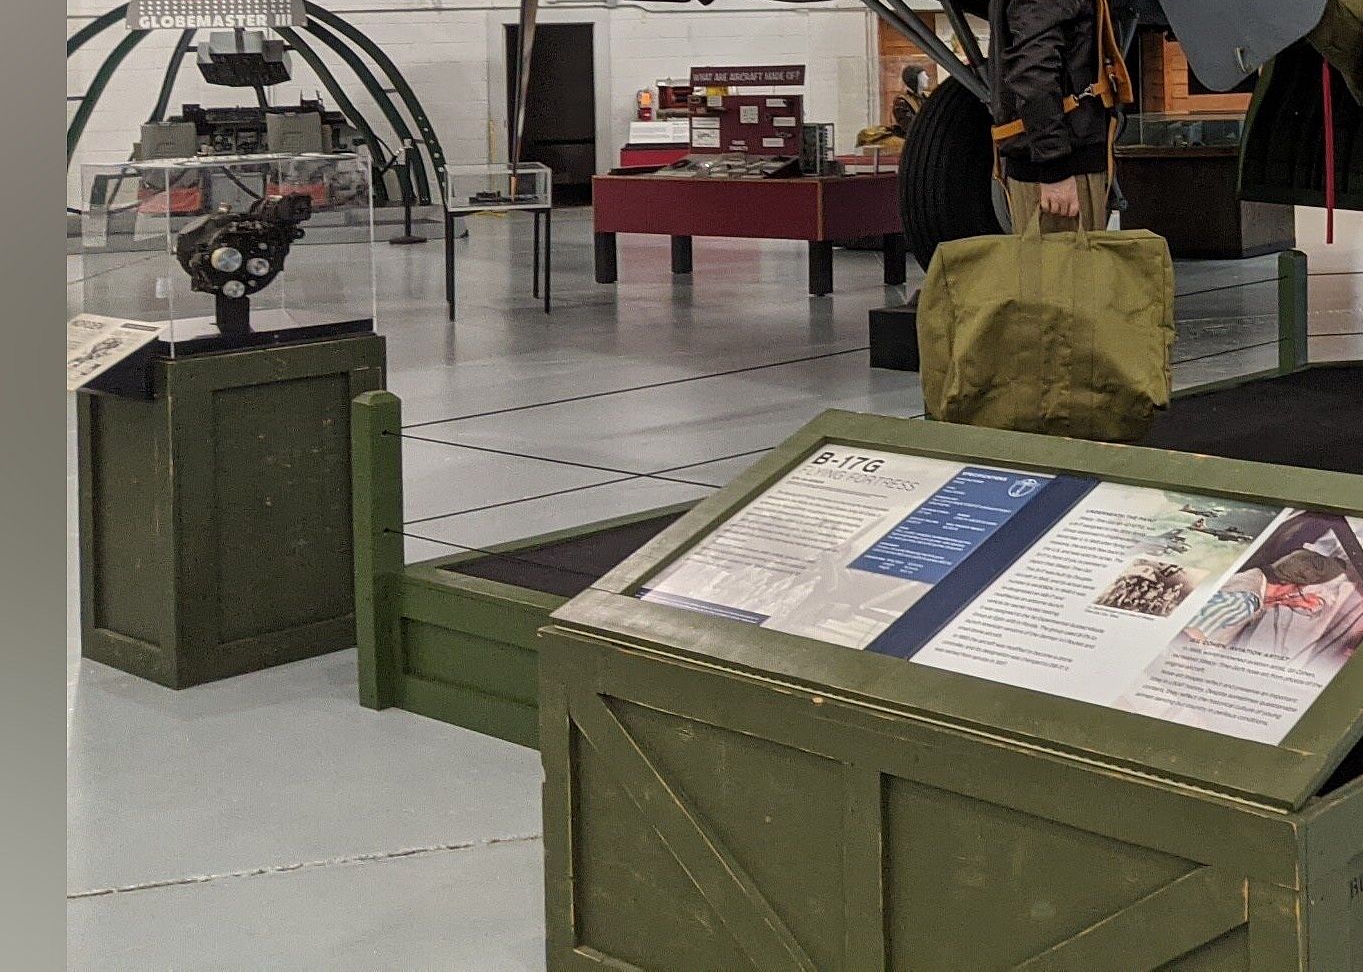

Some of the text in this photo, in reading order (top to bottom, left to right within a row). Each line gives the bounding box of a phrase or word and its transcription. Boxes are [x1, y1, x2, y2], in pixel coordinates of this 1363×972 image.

[138, 14, 293, 28] GLOBEMASTER III
[714, 73, 728, 81] ARE
[729, 72, 763, 81] AIRCRAFT
[811, 451, 885, 474] B-17G
[802, 465, 848, 480] FLYING
[846, 469, 921, 492] FORTRESS
